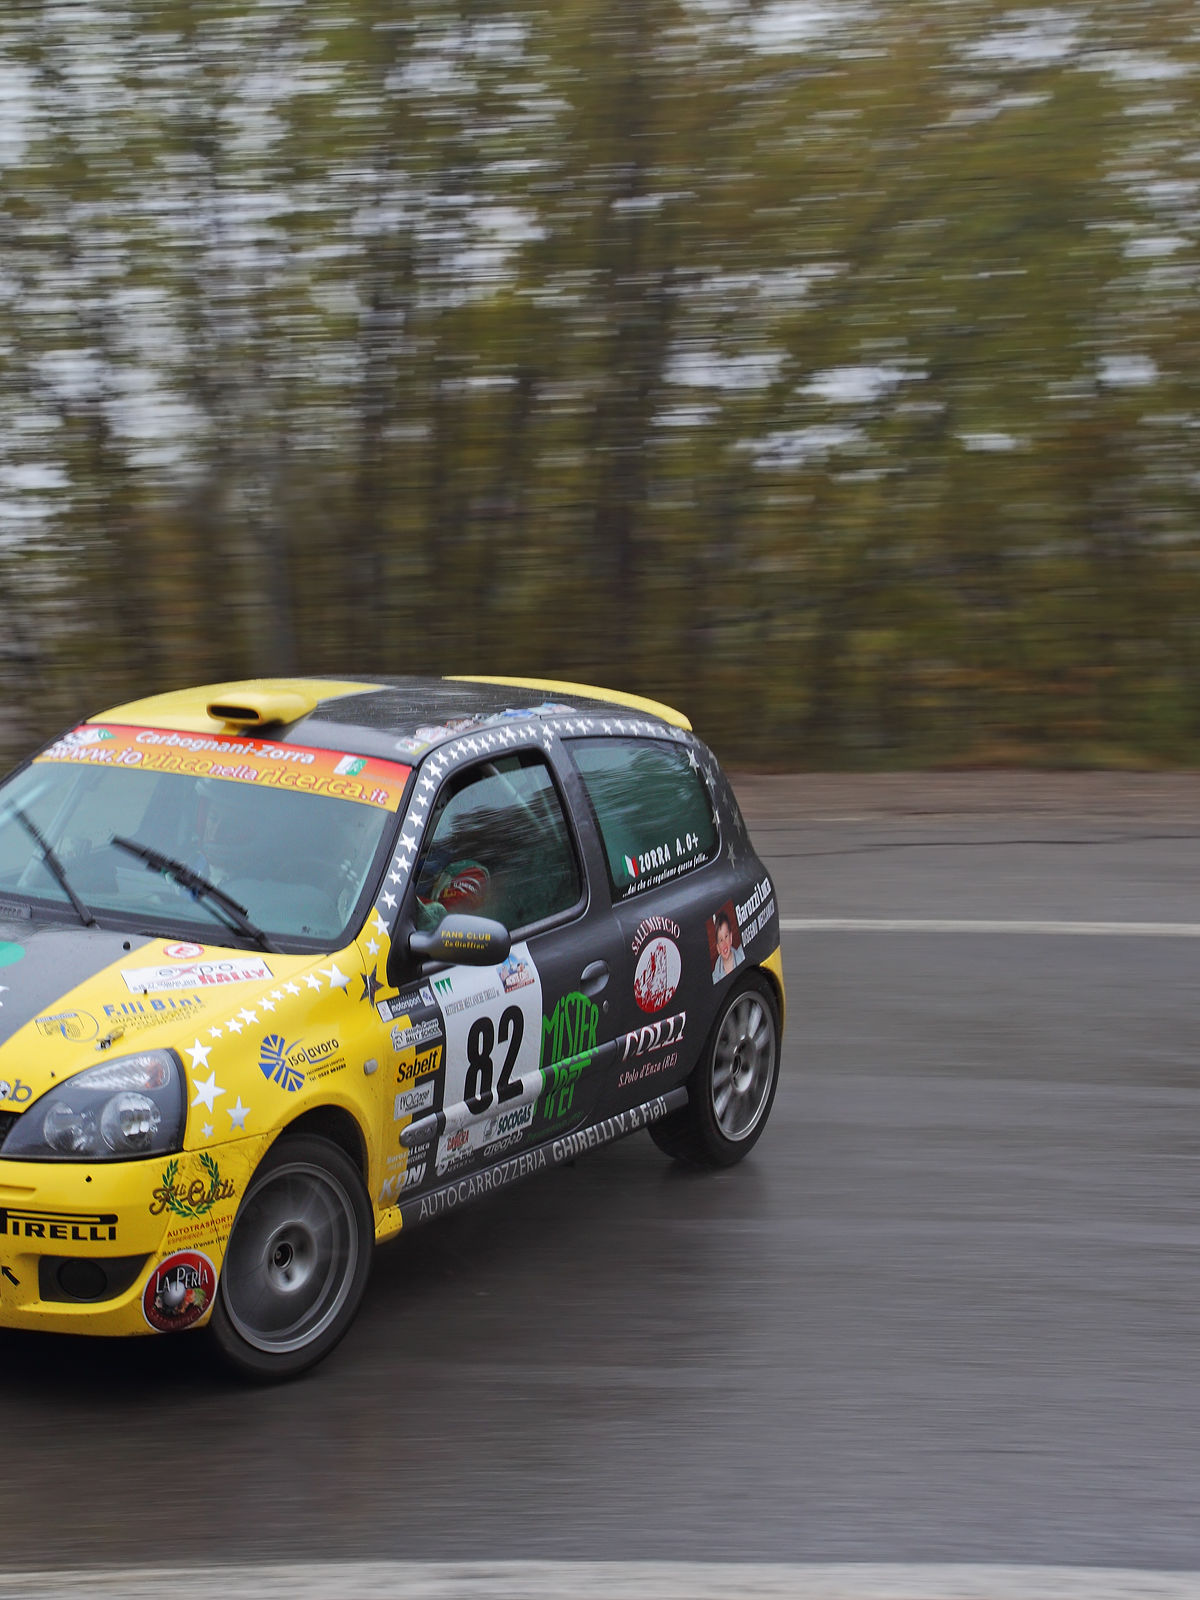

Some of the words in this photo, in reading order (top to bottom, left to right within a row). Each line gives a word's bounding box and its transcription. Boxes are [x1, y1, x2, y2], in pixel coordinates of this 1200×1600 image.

[135, 731, 315, 765] Carbognani-Zorra
[638, 843, 671, 874] ZORRA
[735, 885, 761, 928] Barozzi
[756, 876, 772, 903] Luca
[441, 929, 464, 940] FANS
[466, 931, 491, 942] CLUB
[632, 915, 681, 956] SALUMIFICIO
[198, 968, 266, 985] RALLY
[539, 991, 599, 1074] MISTER
[622, 1011, 687, 1061] COLLI
[396, 1050, 439, 1084] Sabelt
[463, 1003, 525, 1115] 82
[662, 1051, 678, 1072] (RE)
[496, 1104, 532, 1136] SOCOGAS
[418, 1148, 547, 1222] AUTOCARROZZERIA
[552, 1117, 615, 1163] GHIRELLI
[629, 1108, 641, 1129] &
[640, 1096, 668, 1123] Figli
[167, 1214, 234, 1239] AUTOTRASPORTI
[155, 1271, 171, 1294] LA
[175, 1261, 209, 1292] PERLA
